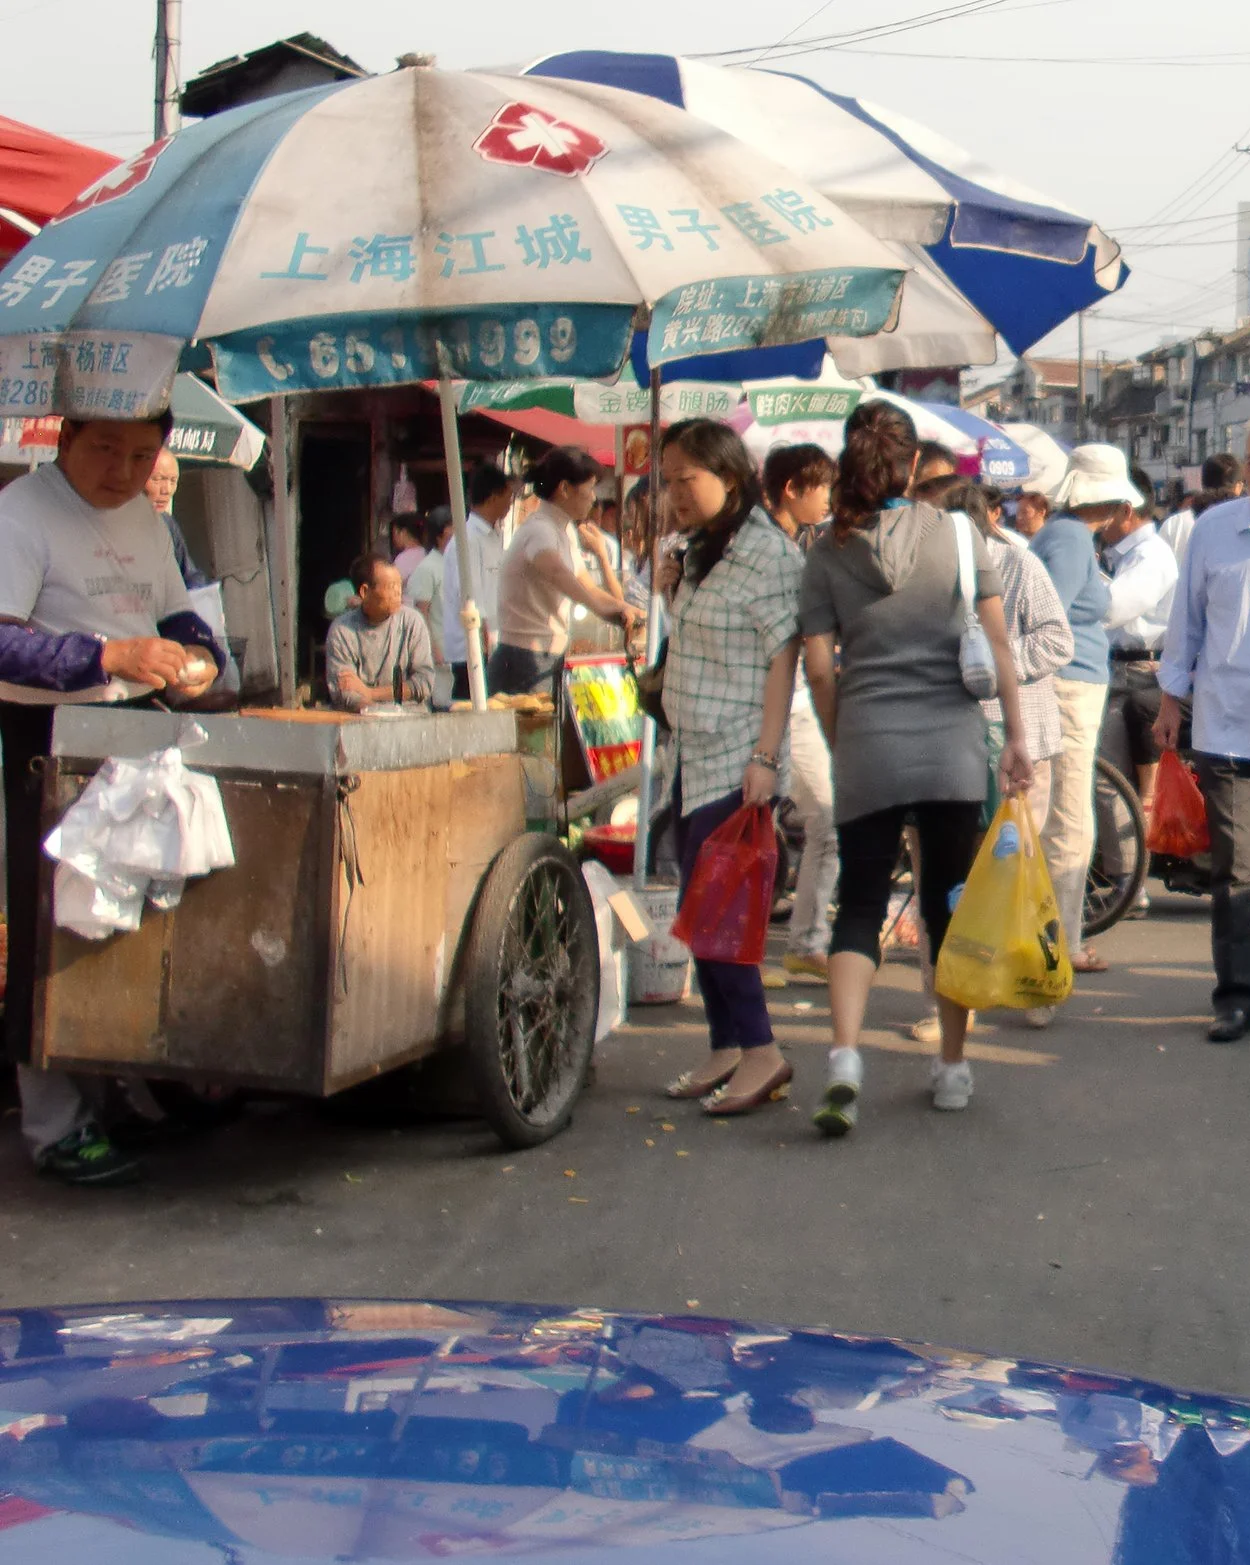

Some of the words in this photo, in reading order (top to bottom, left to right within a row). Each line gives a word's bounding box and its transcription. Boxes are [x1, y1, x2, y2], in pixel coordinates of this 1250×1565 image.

[260, 214, 592, 284] 上海江城
[615, 187, 834, 252] 男子医院
[0, 235, 209, 309] 男子医院
[755, 392, 850, 417] 鲜肉火腿肠
